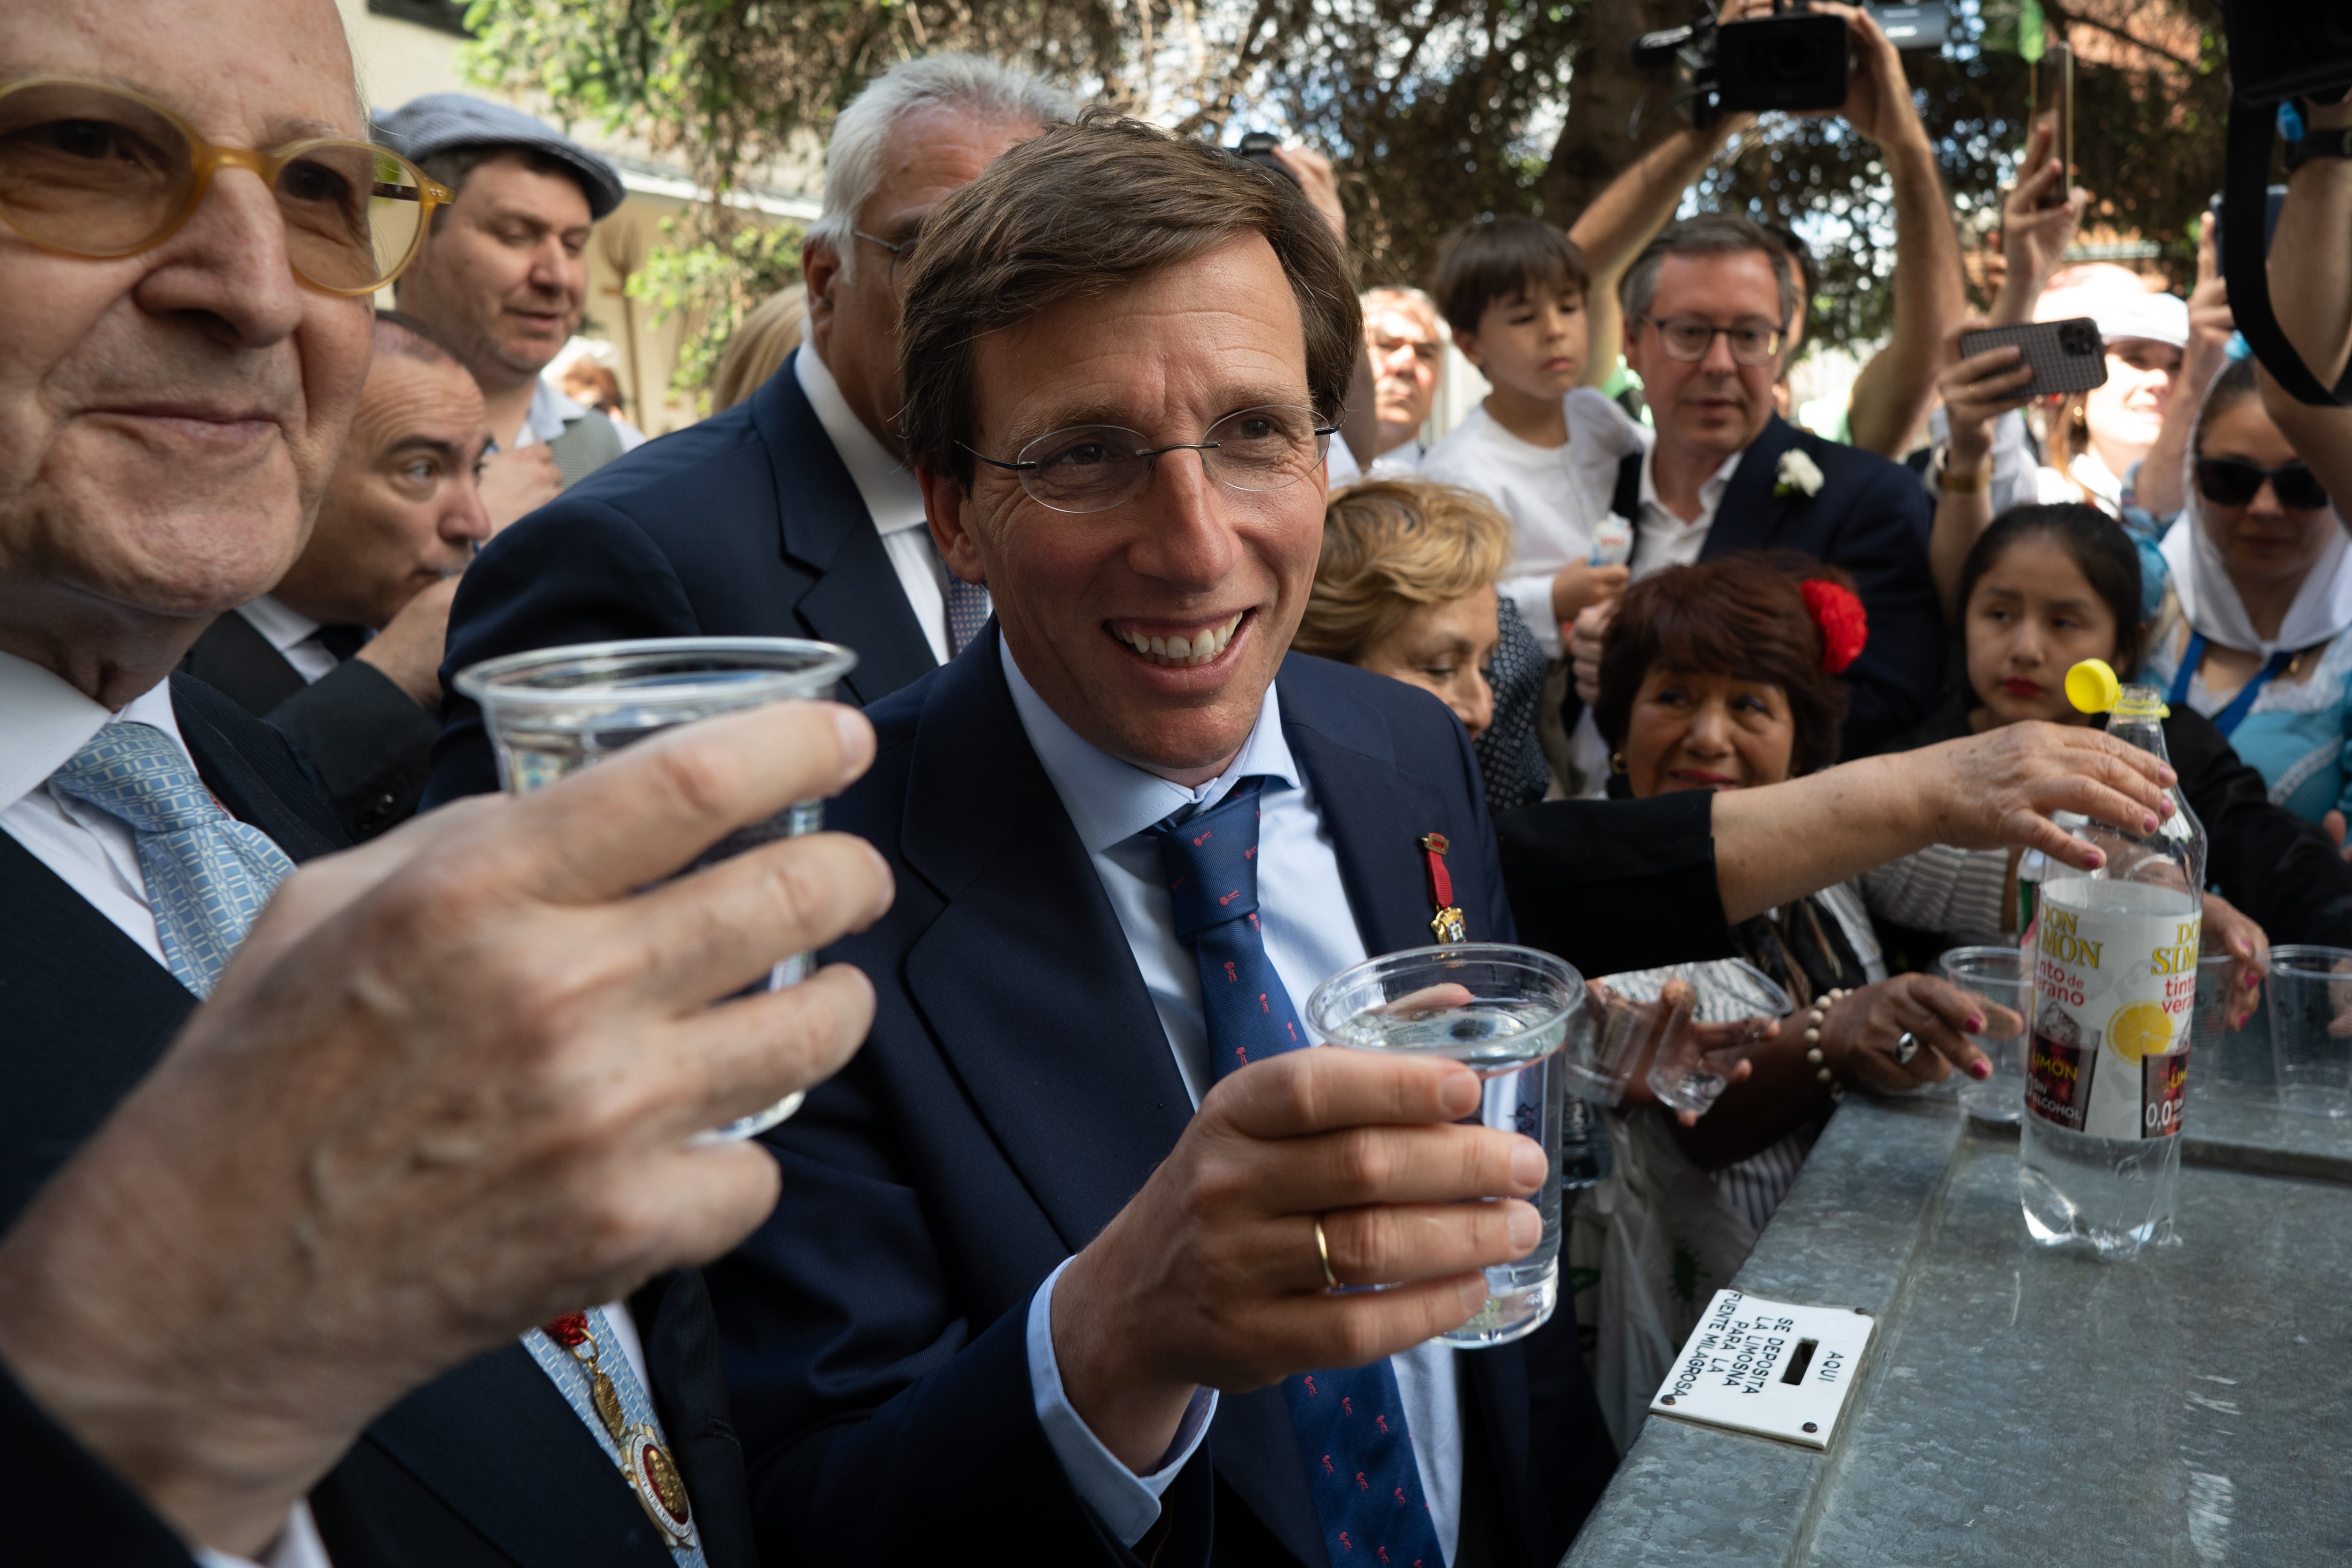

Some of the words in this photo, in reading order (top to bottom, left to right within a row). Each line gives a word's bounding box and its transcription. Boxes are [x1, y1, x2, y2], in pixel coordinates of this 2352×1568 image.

[2067, 973, 2084, 988] de
[2032, 1093, 2082, 1120] ALCOHOL
[2145, 1100, 2171, 1132] 0,0
[1708, 1292, 1742, 1331] FUENTE
[1752, 1316, 1773, 1330] LA
[1773, 1317, 1794, 1333] SE
[1719, 1321, 1749, 1350] PARA
[1672, 1333, 1720, 1396] MILAGROSA
[1707, 1358, 1729, 1372] LA
[1722, 1335, 1764, 1386] LIMOSNA
[1741, 1338, 1785, 1394] DEPOSITA
[1818, 1351, 1844, 1382] AQUI
